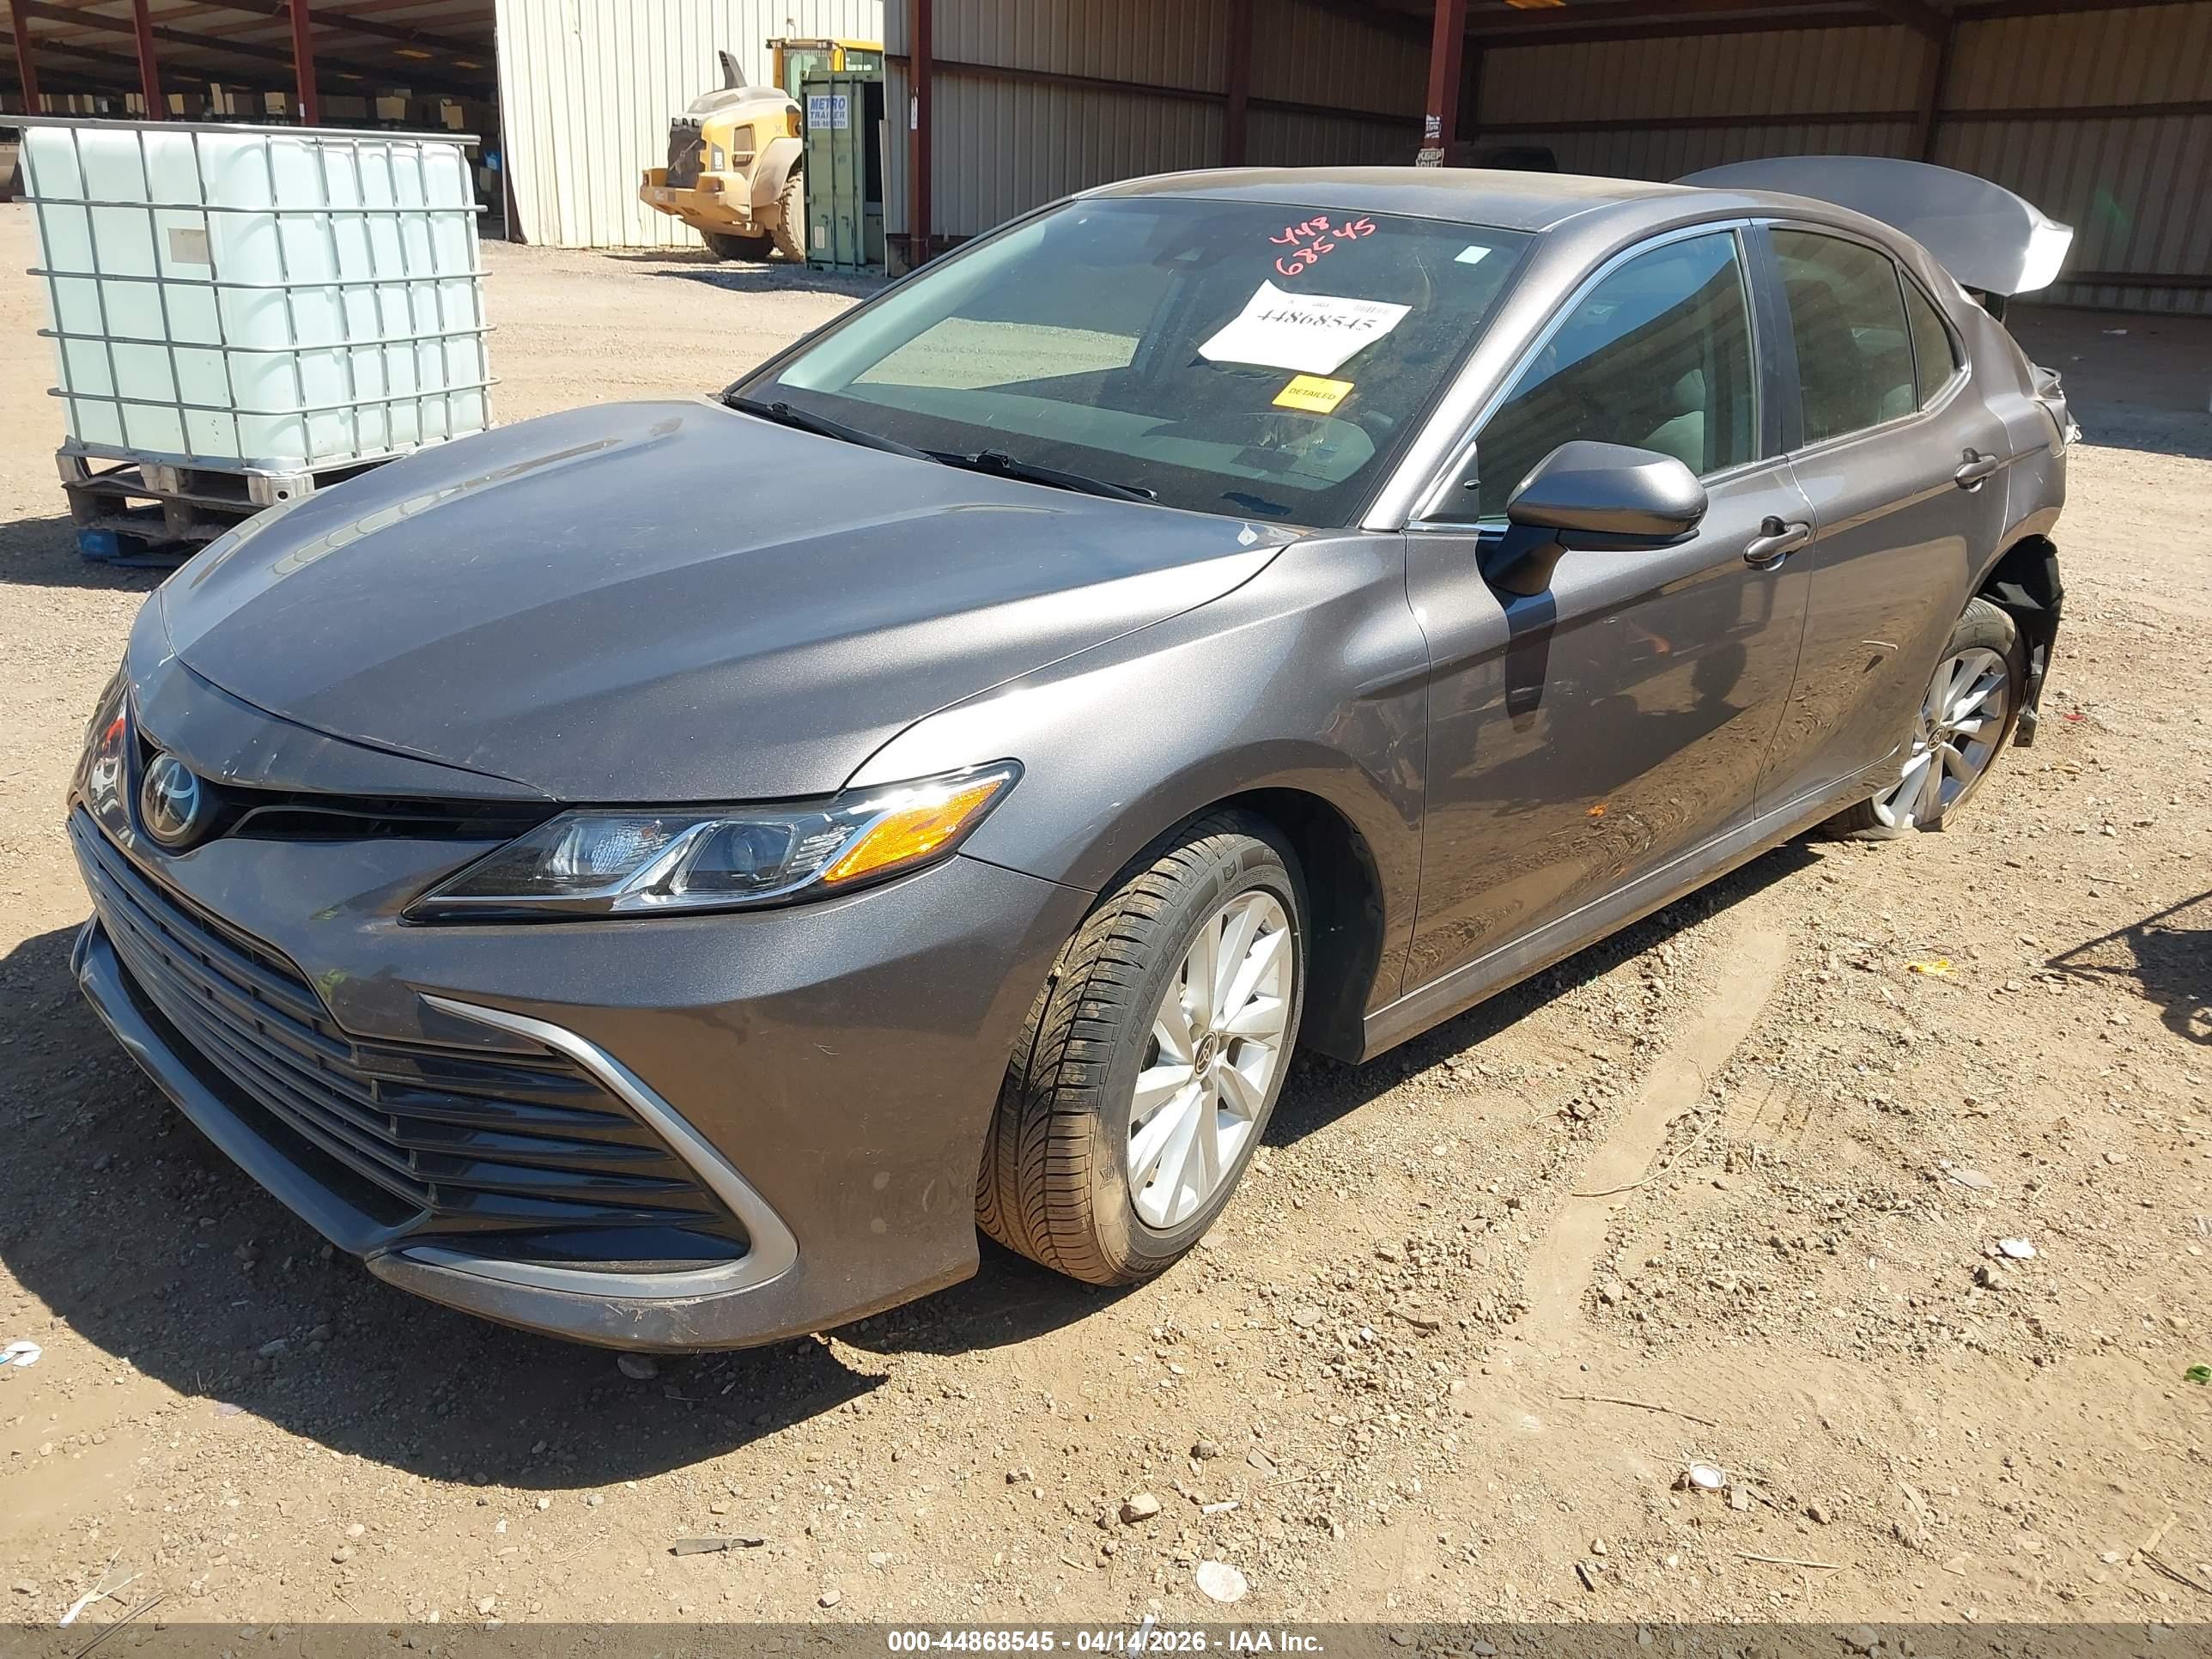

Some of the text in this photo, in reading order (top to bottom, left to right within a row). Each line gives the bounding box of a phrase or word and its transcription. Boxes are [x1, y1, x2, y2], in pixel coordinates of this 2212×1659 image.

[811, 97, 846, 110] METRO
[1418, 150, 1442, 161] KEEP
[1268, 216, 1330, 246] 448
[1288, 387, 1336, 400] DETAILED
